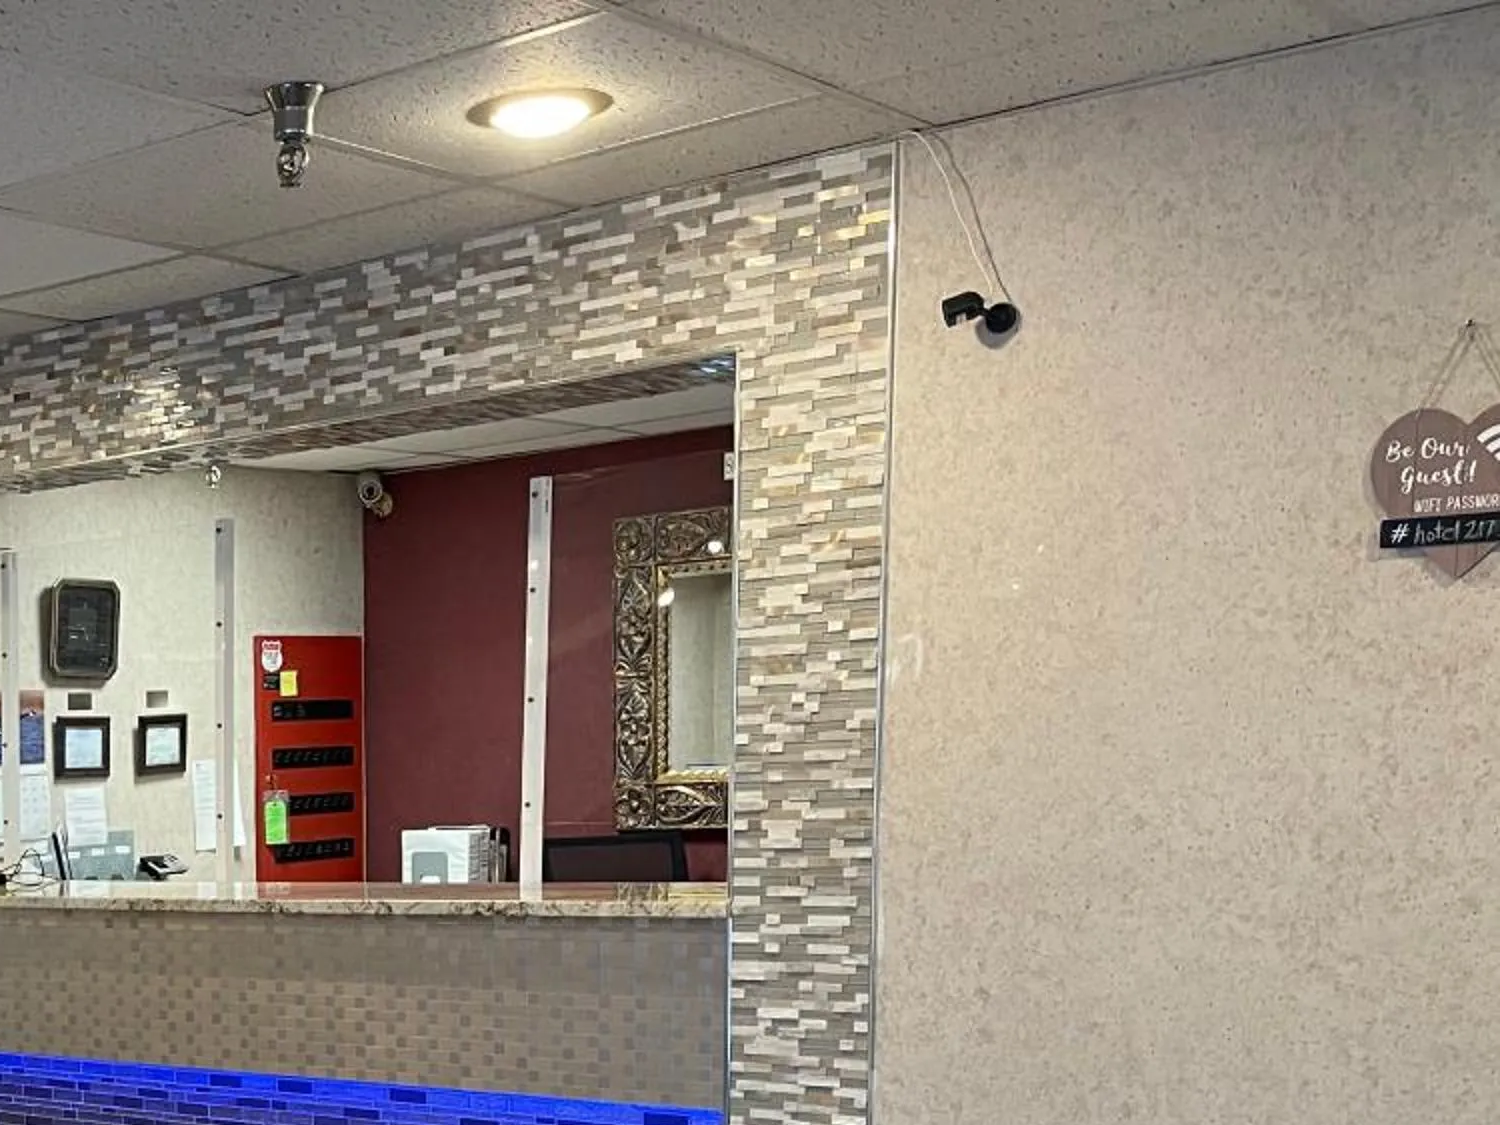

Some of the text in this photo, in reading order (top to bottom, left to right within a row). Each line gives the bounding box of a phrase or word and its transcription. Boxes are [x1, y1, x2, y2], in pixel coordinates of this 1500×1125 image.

[1385, 437, 1469, 463] Be Our
[1445, 493, 1500, 511] PASSWOR
